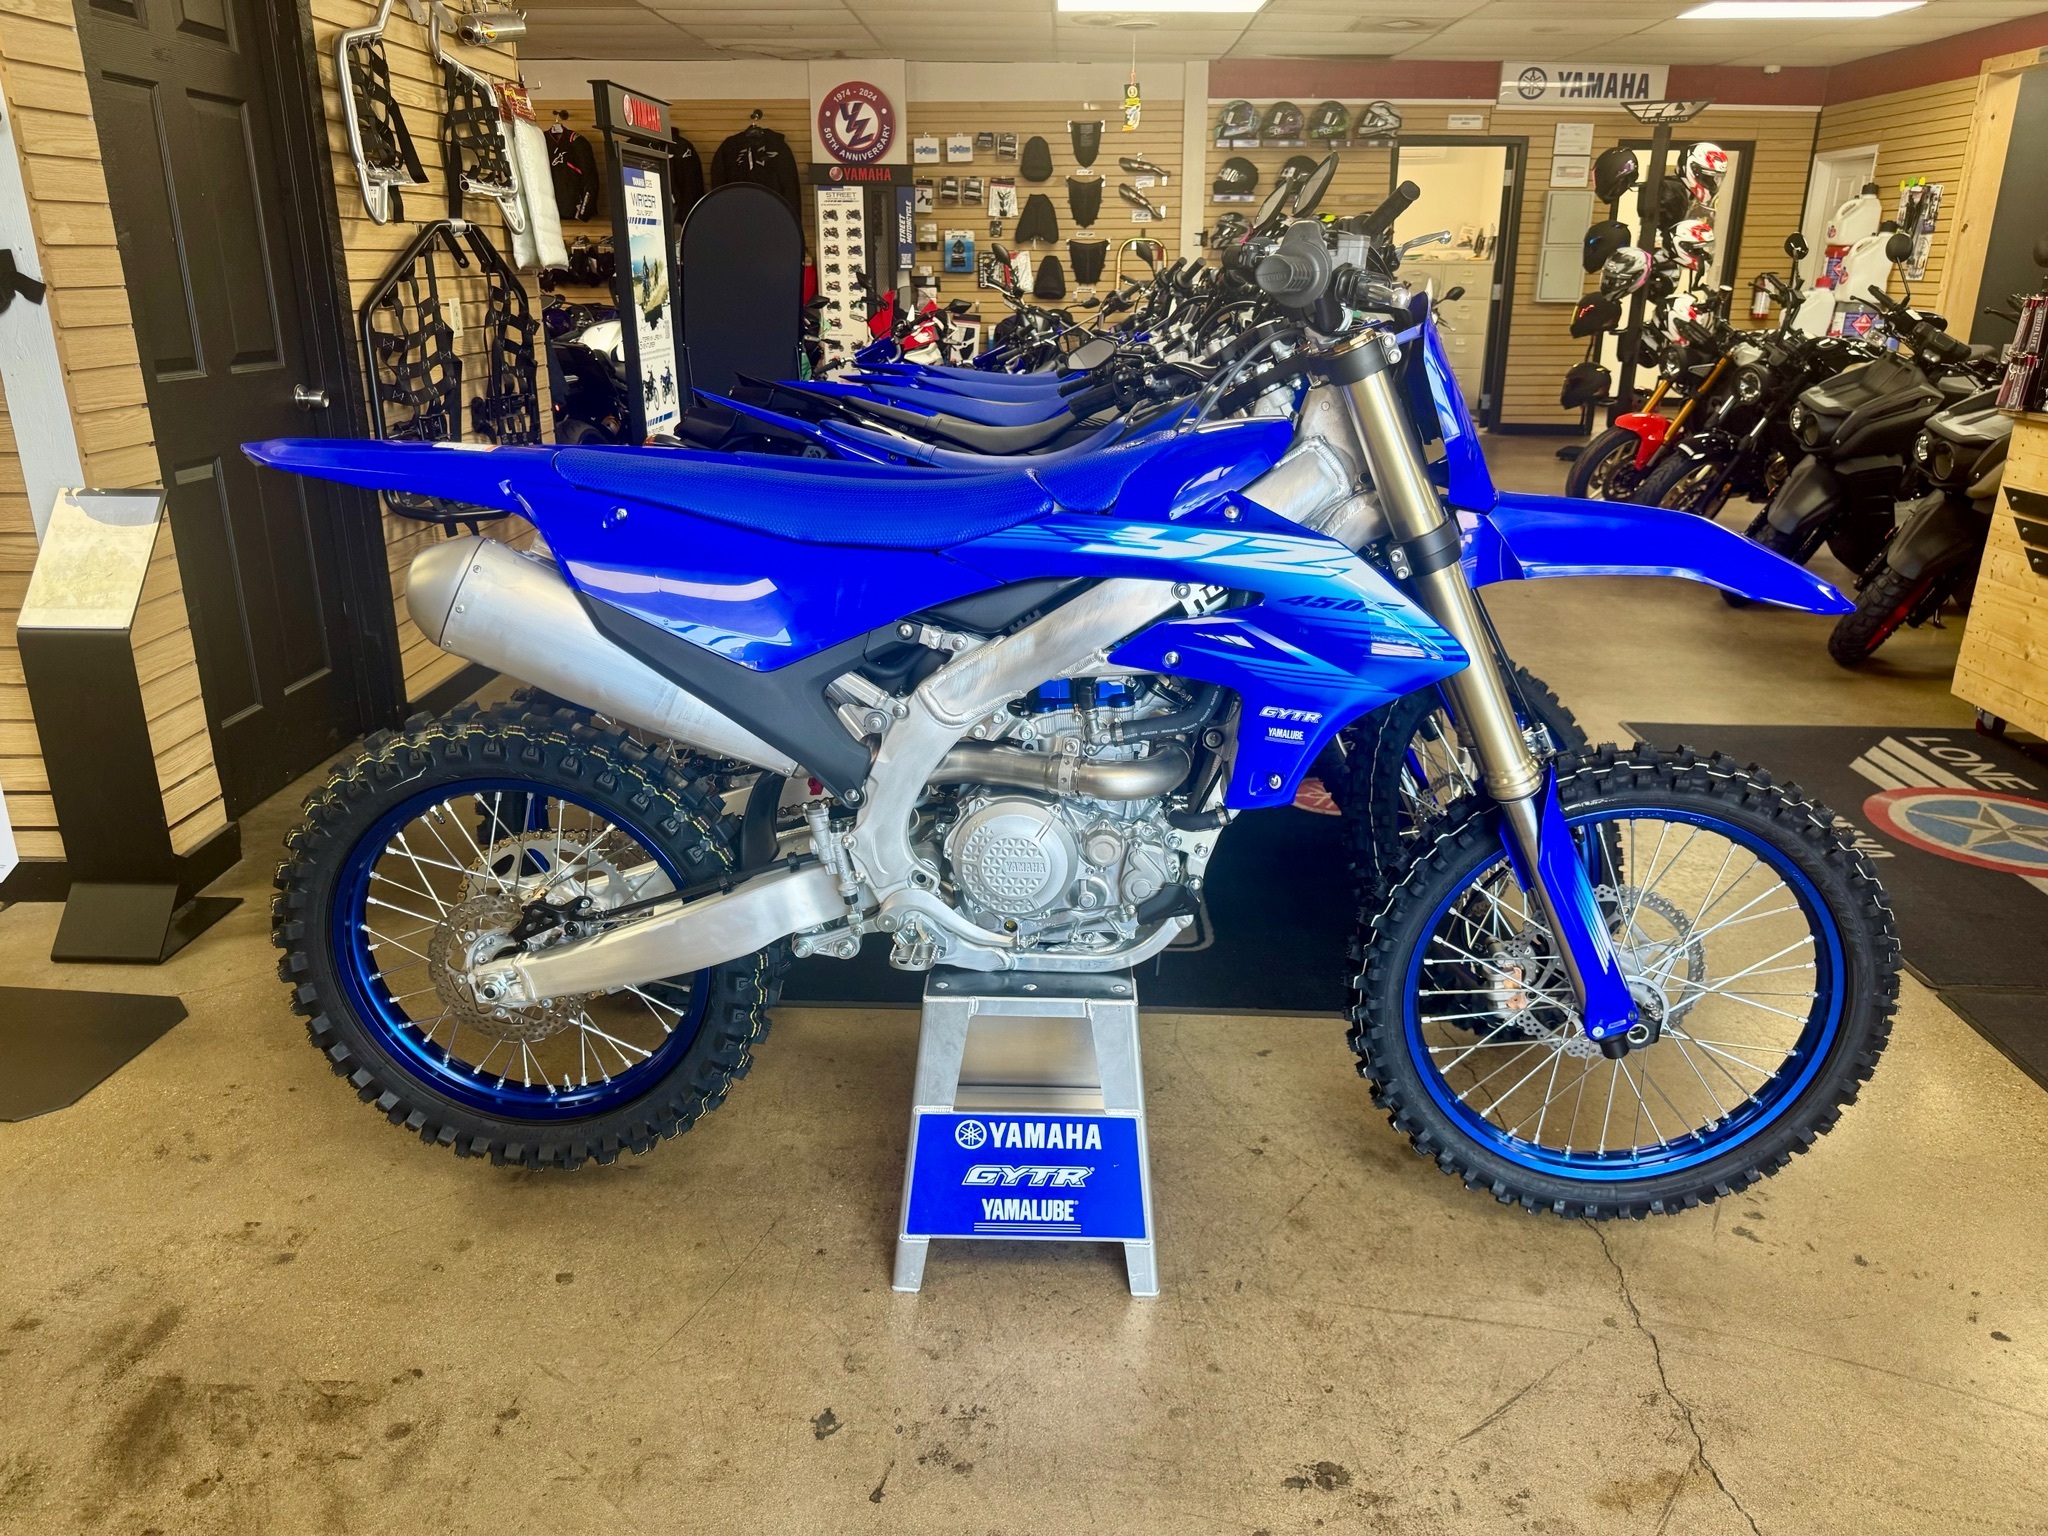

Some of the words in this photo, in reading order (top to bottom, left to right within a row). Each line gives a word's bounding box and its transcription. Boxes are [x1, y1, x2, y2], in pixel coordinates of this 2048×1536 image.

[833, 88, 851, 103] 1974
[859, 87, 878, 102] 2024
[1558, 71, 1650, 100] YAMAHA
[840, 102, 875, 148] YZ
[823, 127, 840, 151] 50TH
[839, 124, 891, 162] ANNIVERSARY
[843, 167, 892, 181] YAMAHA
[898, 213, 906, 244] STREET
[905, 200, 913, 244] MOTORCYCLE
[1259, 706, 1323, 724] GYTR
[1268, 727, 1304, 741] YAMALUBE
[1906, 736, 2039, 791] LONE
[1004, 860, 1046, 874] YAMAHA
[989, 1121, 1102, 1150] YAMAHA
